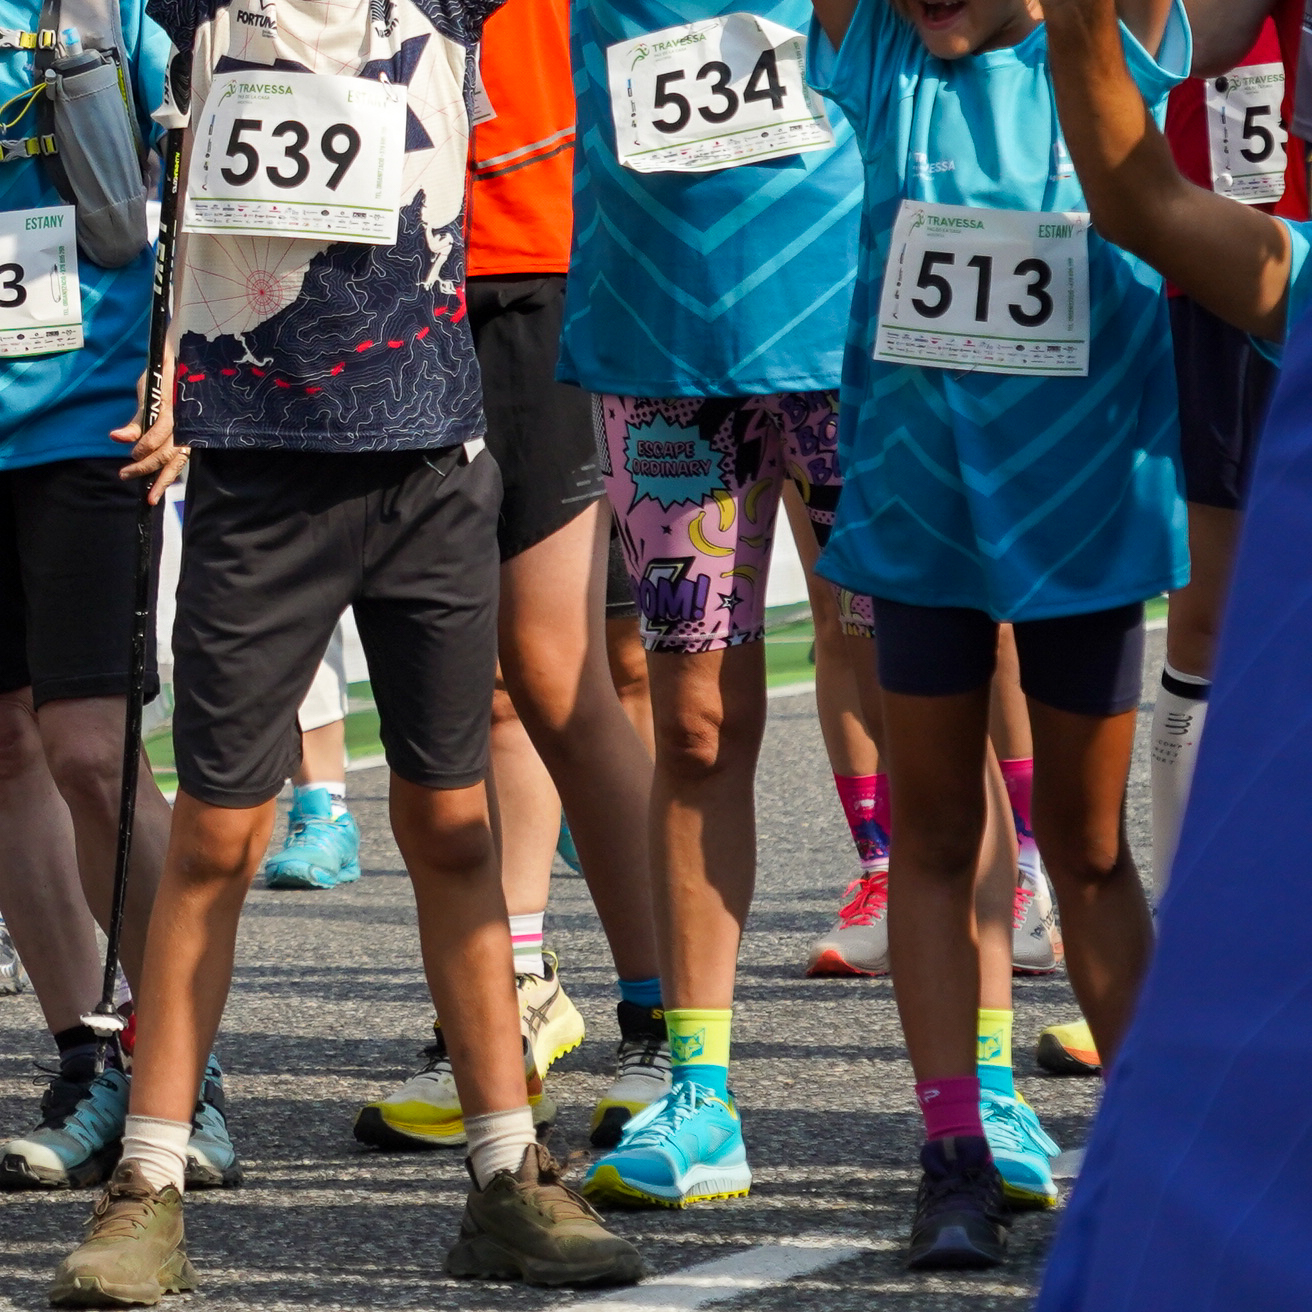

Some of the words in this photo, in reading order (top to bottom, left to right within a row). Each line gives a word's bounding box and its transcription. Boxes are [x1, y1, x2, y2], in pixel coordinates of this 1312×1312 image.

[652, 32, 707, 53] TRAVESSA
[238, 83, 294, 95] TRAVESSA
[651, 48, 788, 135] 534
[1240, 105, 1285, 164] 5
[220, 118, 362, 191] 539
[25, 214, 64, 231] ESTANY
[927, 215, 985, 229] TRAVESSA
[1038, 223, 1074, 238] ESTANY
[911, 250, 1054, 327] 513
[637, 440, 696, 459] ESCAPE
[632, 459, 712, 479] ORDINARY
